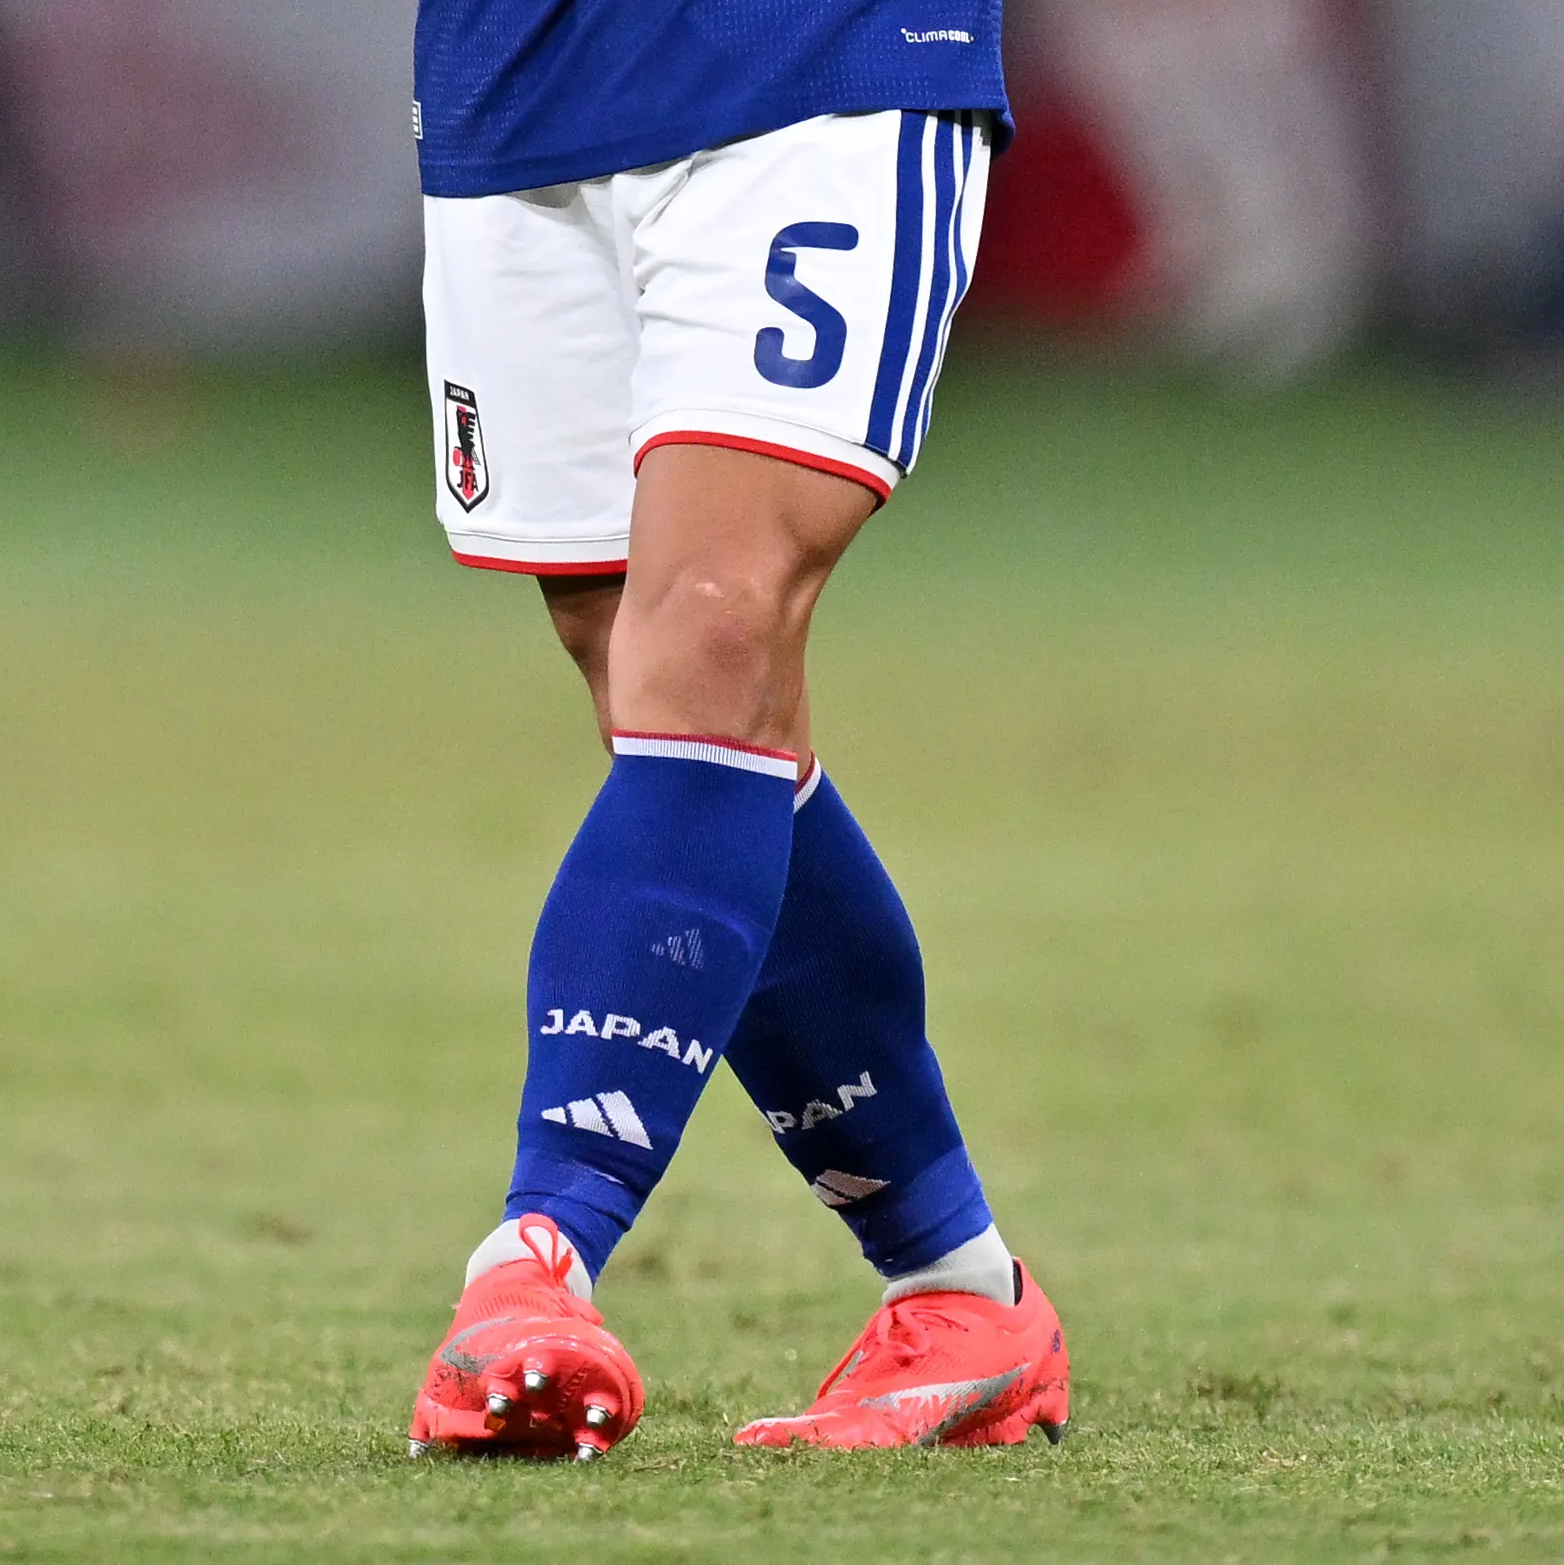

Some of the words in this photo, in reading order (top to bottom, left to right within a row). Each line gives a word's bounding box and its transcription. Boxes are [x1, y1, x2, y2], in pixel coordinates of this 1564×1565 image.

[754, 221, 859, 389] 5
[540, 1008, 714, 1074] JAPAN
[765, 1070, 877, 1134] PAN
